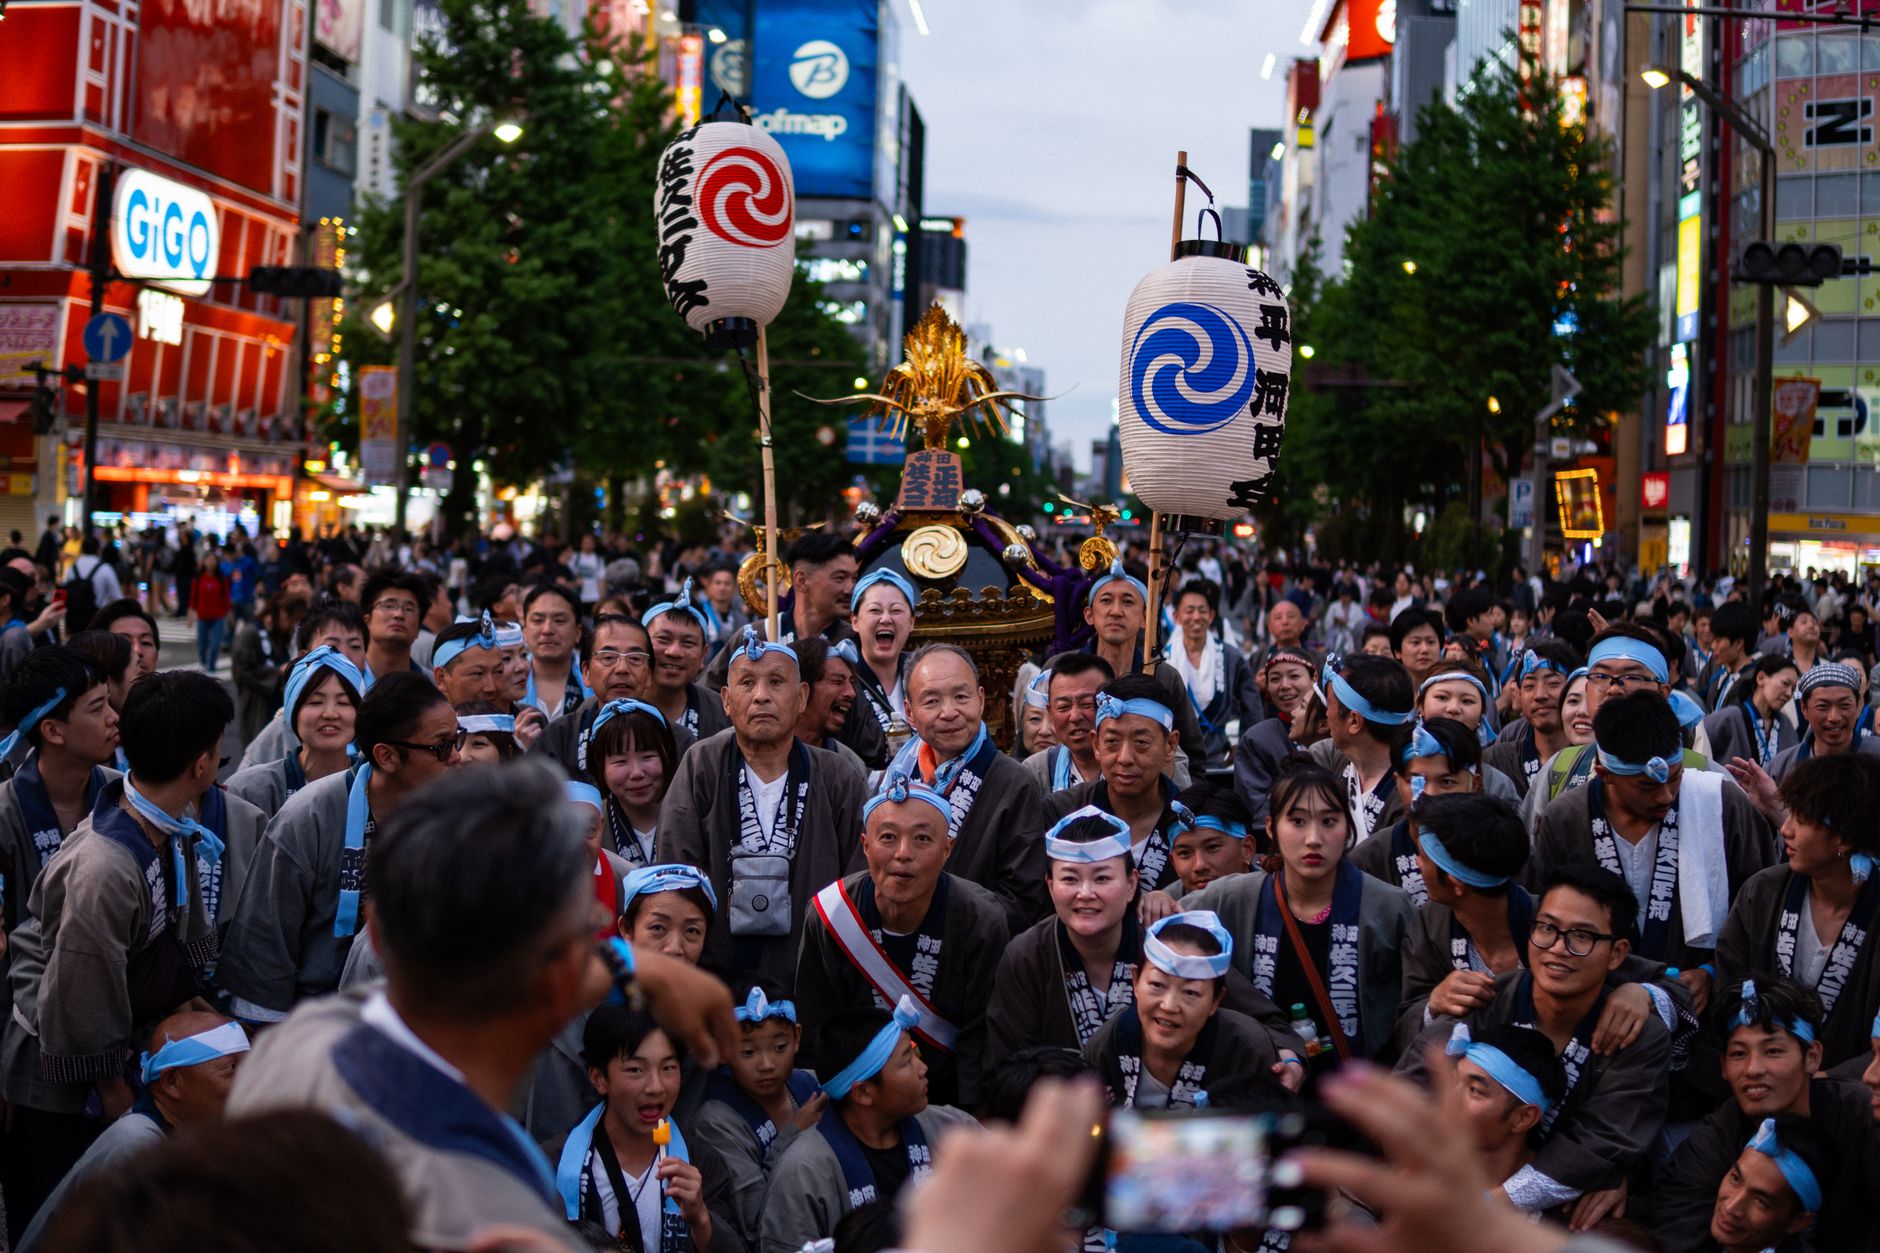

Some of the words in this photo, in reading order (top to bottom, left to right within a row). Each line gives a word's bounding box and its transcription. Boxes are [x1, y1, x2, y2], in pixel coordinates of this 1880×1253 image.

[904, 463, 931, 507] 佐久二
[1516, 484, 1530, 503] P
[959, 768, 982, 792] 神田
[948, 786, 974, 839] 佐久二
[1648, 827, 1679, 921] 佐久二平河
[917, 934, 943, 954] 神田
[1254, 934, 1279, 954] 神田
[1331, 924, 1359, 942] 神田
[1842, 922, 1866, 946] 神田
[1180, 1061, 1206, 1081] 神田
[755, 1120, 777, 1145] 神田
